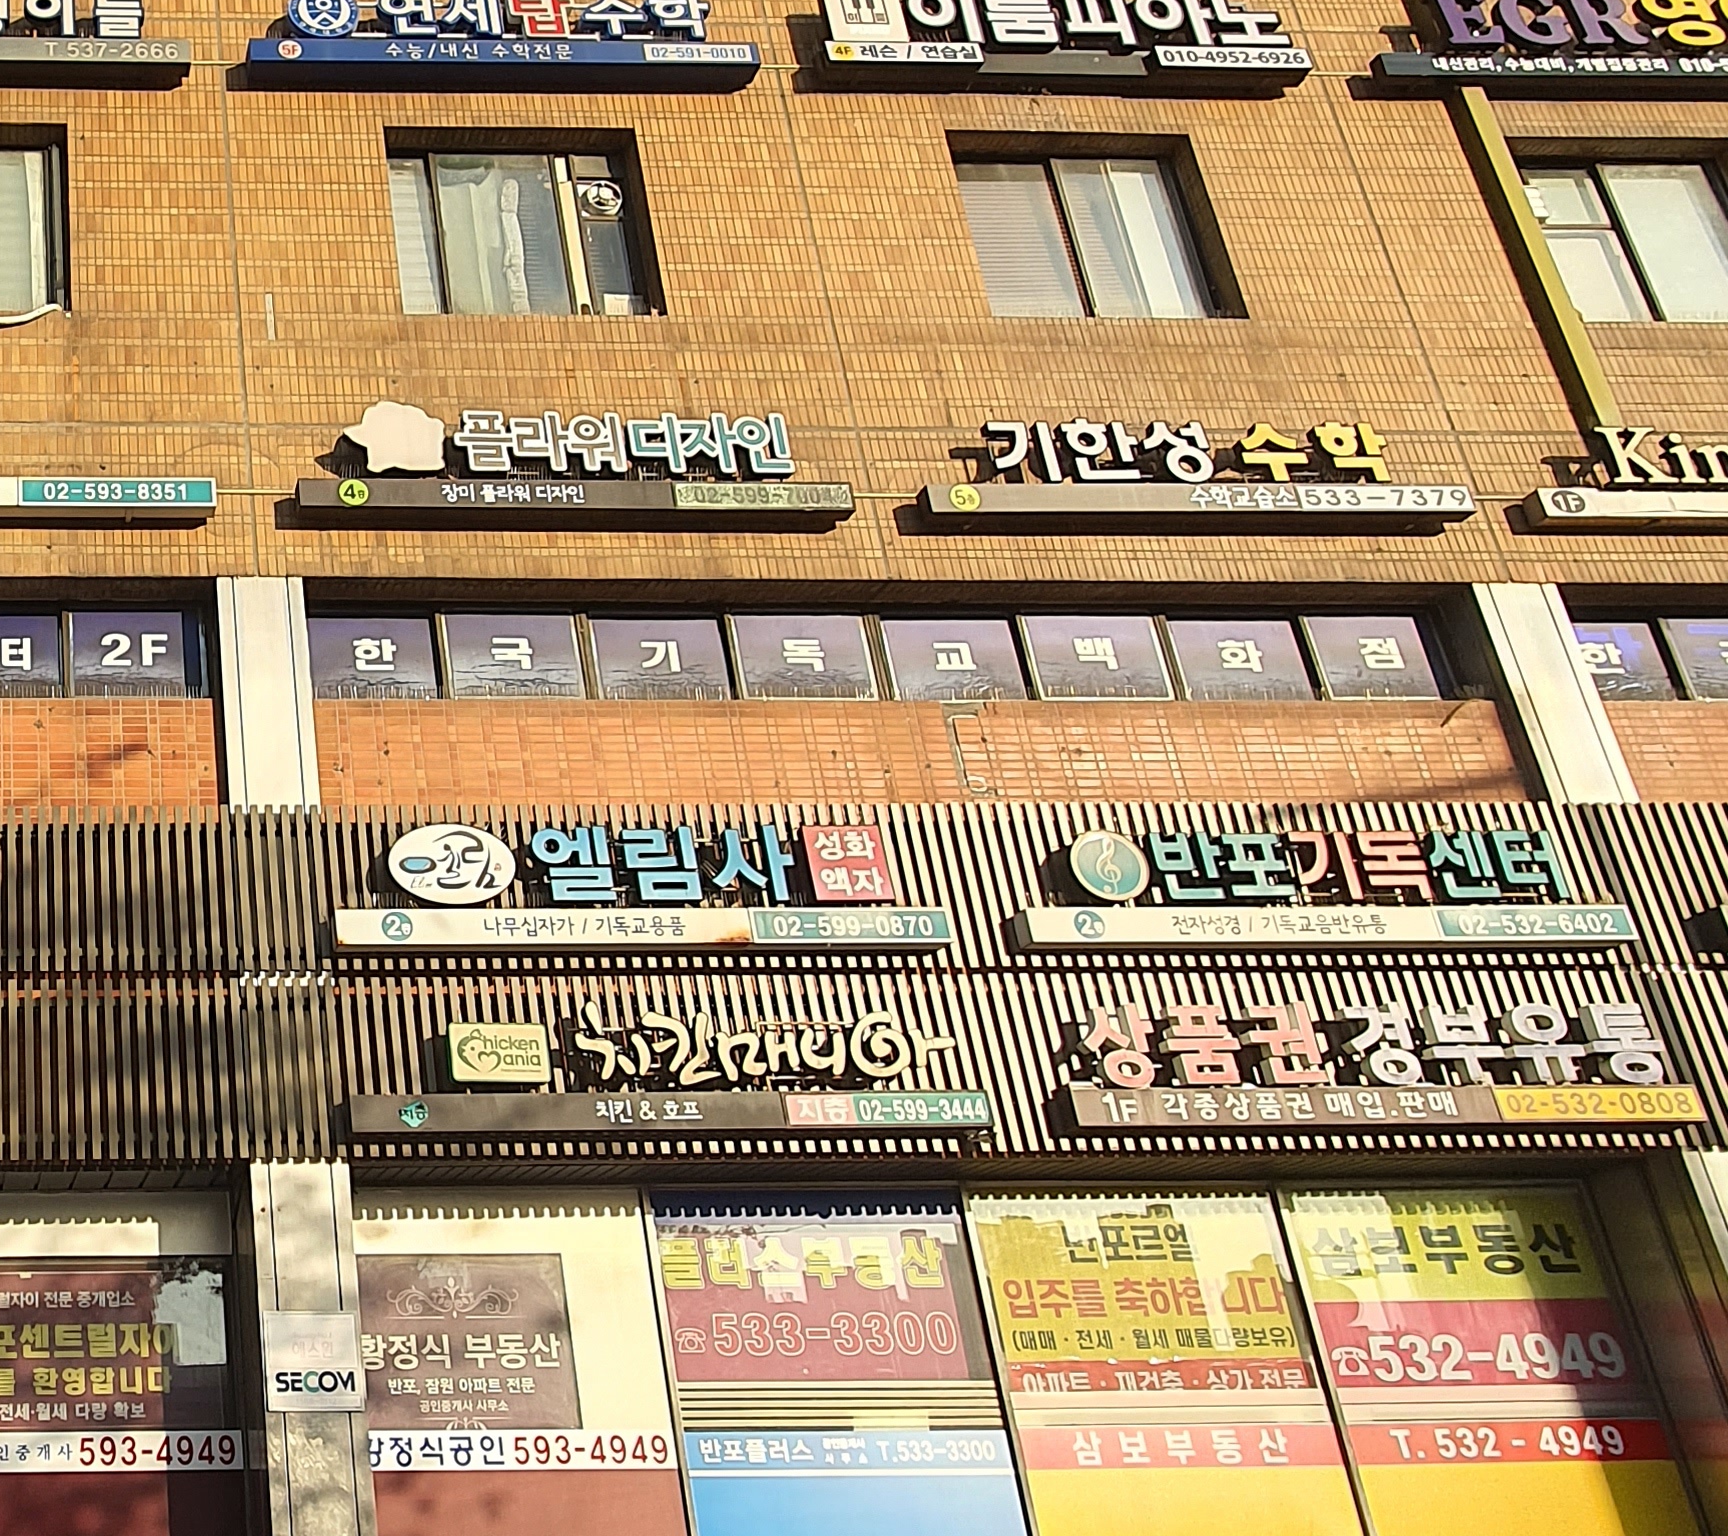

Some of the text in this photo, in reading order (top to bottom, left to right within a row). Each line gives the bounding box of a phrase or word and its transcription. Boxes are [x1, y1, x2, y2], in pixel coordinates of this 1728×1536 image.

[46, 41, 179, 59] T.537-2666
[282, 42, 747, 61] 5F 수능/내신 수학전문 02-591-0010
[834, 43, 1305, 66] 4F 레슨 연습실 010-4952-6926
[986, 417, 1391, 483] 기한성 수학
[42, 482, 188, 502] 02-593-8351
[440, 484, 584, 504] 장미 플라워 디자인
[1190, 487, 1468, 510] 수학교습소 533-7379
[101, 633, 169, 667] 2F
[813, 833, 875, 862] 성화
[530, 825, 795, 903] 엘림사
[1150, 830, 1572, 901] 반포기독센터
[820, 866, 883, 896] 액자
[483, 914, 933, 938] 나무십자가 기독교용품 02-599-0870
[1170, 912, 1618, 936] 전자성경 기독교음반유통 02-532-6402
[595, 1100, 633, 1123] 치킨
[662, 1101, 703, 1122] 호프
[859, 1097, 988, 1124] 02-599-3444
[1102, 1091, 1694, 1124] 1F 각종상품권 매입.판매 02-532-0808
[43, 1291, 73, 1309] 전문
[76, 1291, 136, 1308] 중개업소
[1003, 1277, 1108, 1319] 입주를
[712, 1311, 958, 1357] 533-3300
[1075, 1328, 1114, 1351] 전세
[1132, 1328, 1170, 1350] 월세
[360, 1332, 562, 1371] 황정식 부동산
[1366, 1331, 1628, 1383] 532-4949
[32, 1365, 172, 1396] 환영합니다
[275, 1371, 356, 1393] SECOM
[387, 1377, 536, 1396] 반포, 잠원 아파트 전문
[75, 1402, 107, 1421] 다량
[113, 1402, 147, 1421] 확보
[419, 1398, 510, 1414] 공인중개사 사무소
[79, 1435, 237, 1467] 593-4949
[514, 1434, 669, 1465] 593-4949
[699, 1438, 996, 1464] 반포플러스 T.533-3300
